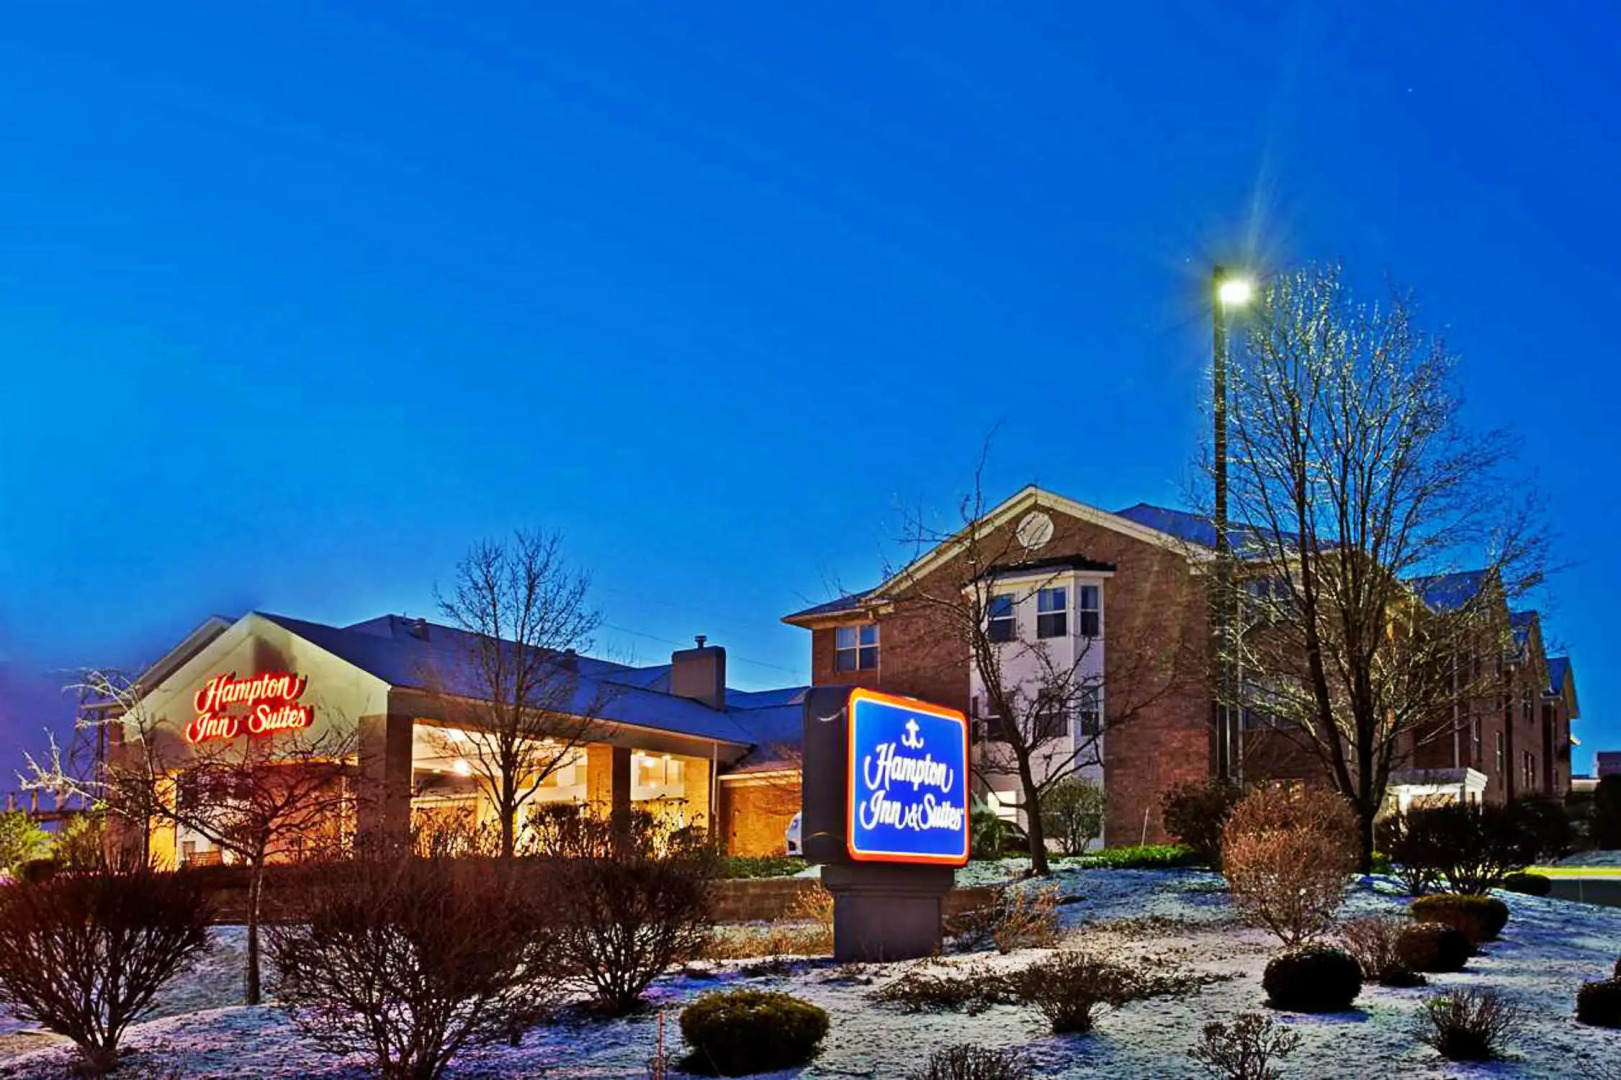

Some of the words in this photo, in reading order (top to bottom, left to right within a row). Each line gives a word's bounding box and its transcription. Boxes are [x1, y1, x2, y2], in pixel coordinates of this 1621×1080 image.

[194, 673, 300, 714] Hampton
[186, 712, 238, 743] Inn
[249, 704, 307, 733] Suites
[864, 742, 953, 793] Hampton
[860, 789, 908, 830] Inn
[908, 803, 920, 831] &
[918, 793, 963, 831] Suites
